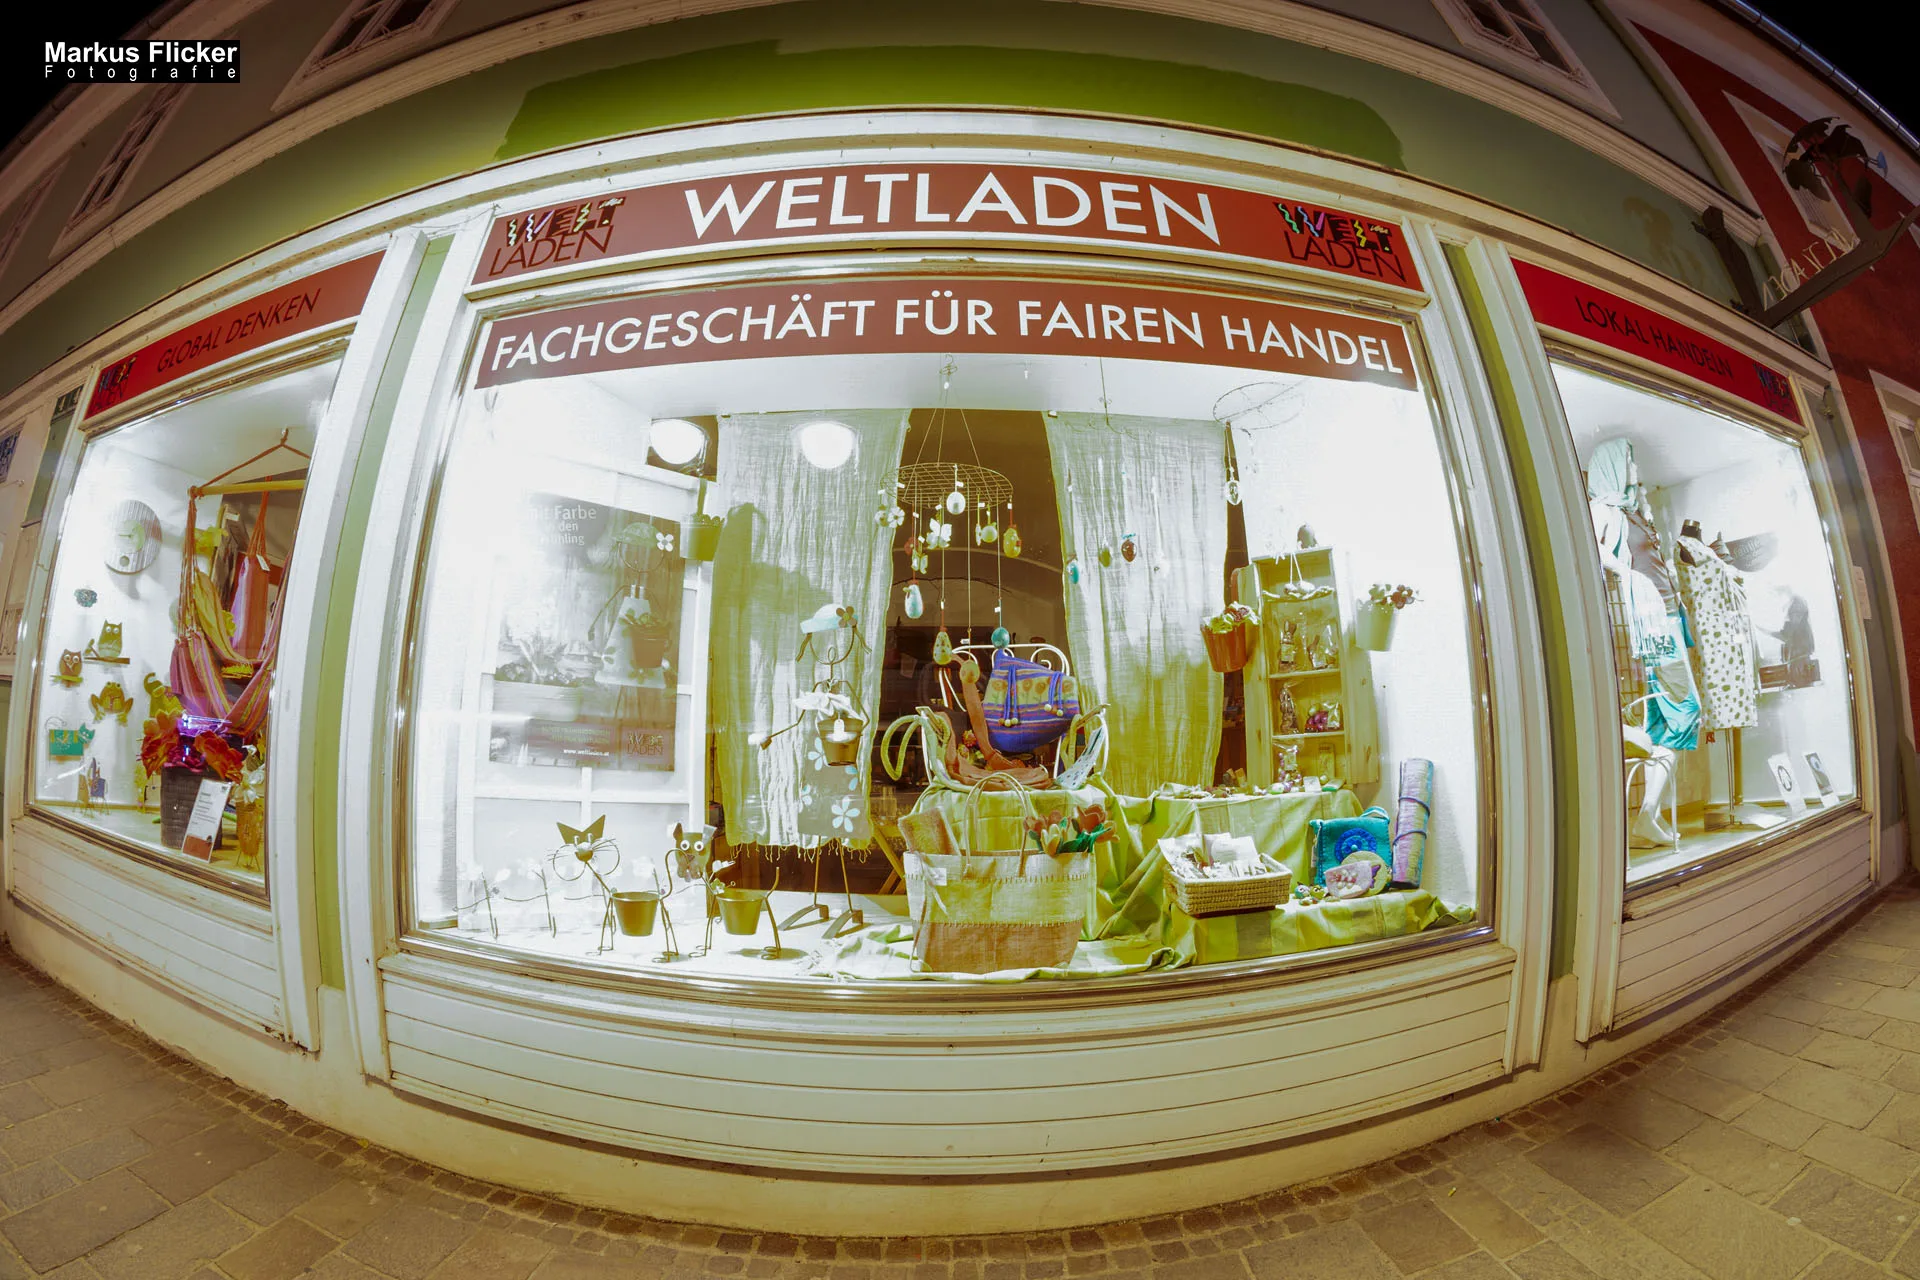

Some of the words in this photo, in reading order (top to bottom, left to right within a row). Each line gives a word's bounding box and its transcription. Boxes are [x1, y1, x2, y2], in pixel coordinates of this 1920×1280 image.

[507, 196, 626, 247] WELT
[684, 172, 1220, 246] WELTLADEN
[1273, 202, 1392, 254] WELT
[488, 225, 614, 276] LADEN
[1284, 231, 1407, 282] LADEN
[157, 326, 221, 373] GLOBAL
[225, 288, 322, 344] DENKEN
[491, 293, 875, 371] FACHGESCHÄFT
[896, 289, 997, 336] FÜR
[1019, 300, 1205, 349] FAIREN
[1221, 315, 1403, 374] HANDEL
[1575, 296, 1649, 344] LOKAL
[1648, 325, 1735, 380] HANDELN
[554, 504, 597, 520] Farbe
[559, 520, 579, 533] den
[627, 744, 664, 756] LADEN
